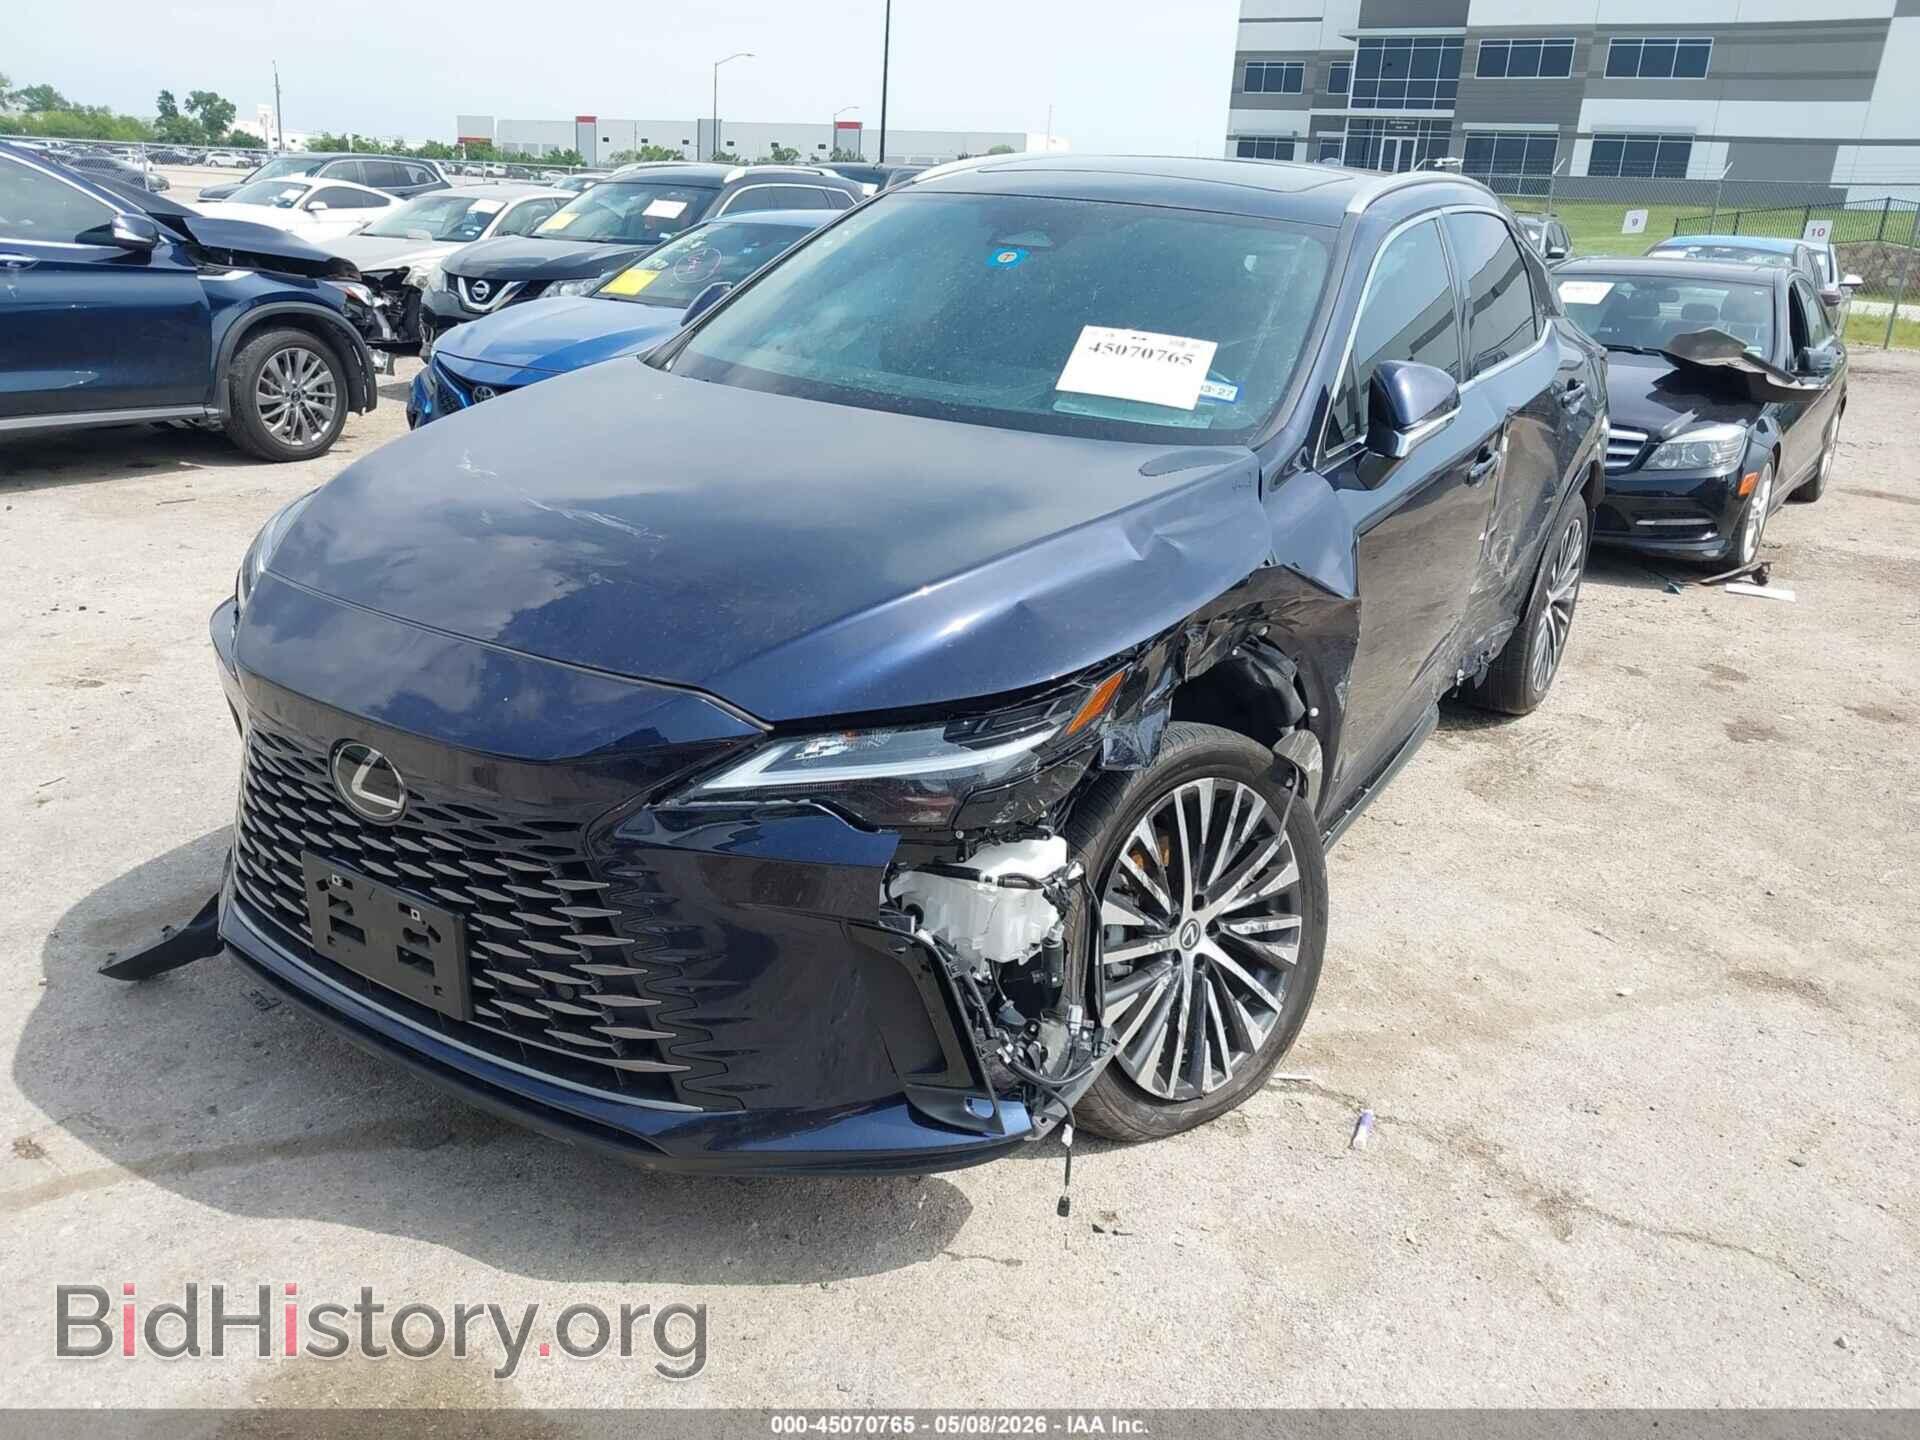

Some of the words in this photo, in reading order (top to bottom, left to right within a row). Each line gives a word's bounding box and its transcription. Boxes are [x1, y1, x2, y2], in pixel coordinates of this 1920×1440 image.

[1631, 218, 1638, 227] 9
[1811, 227, 1826, 238] 10
[1088, 342, 1195, 366] 45070765
